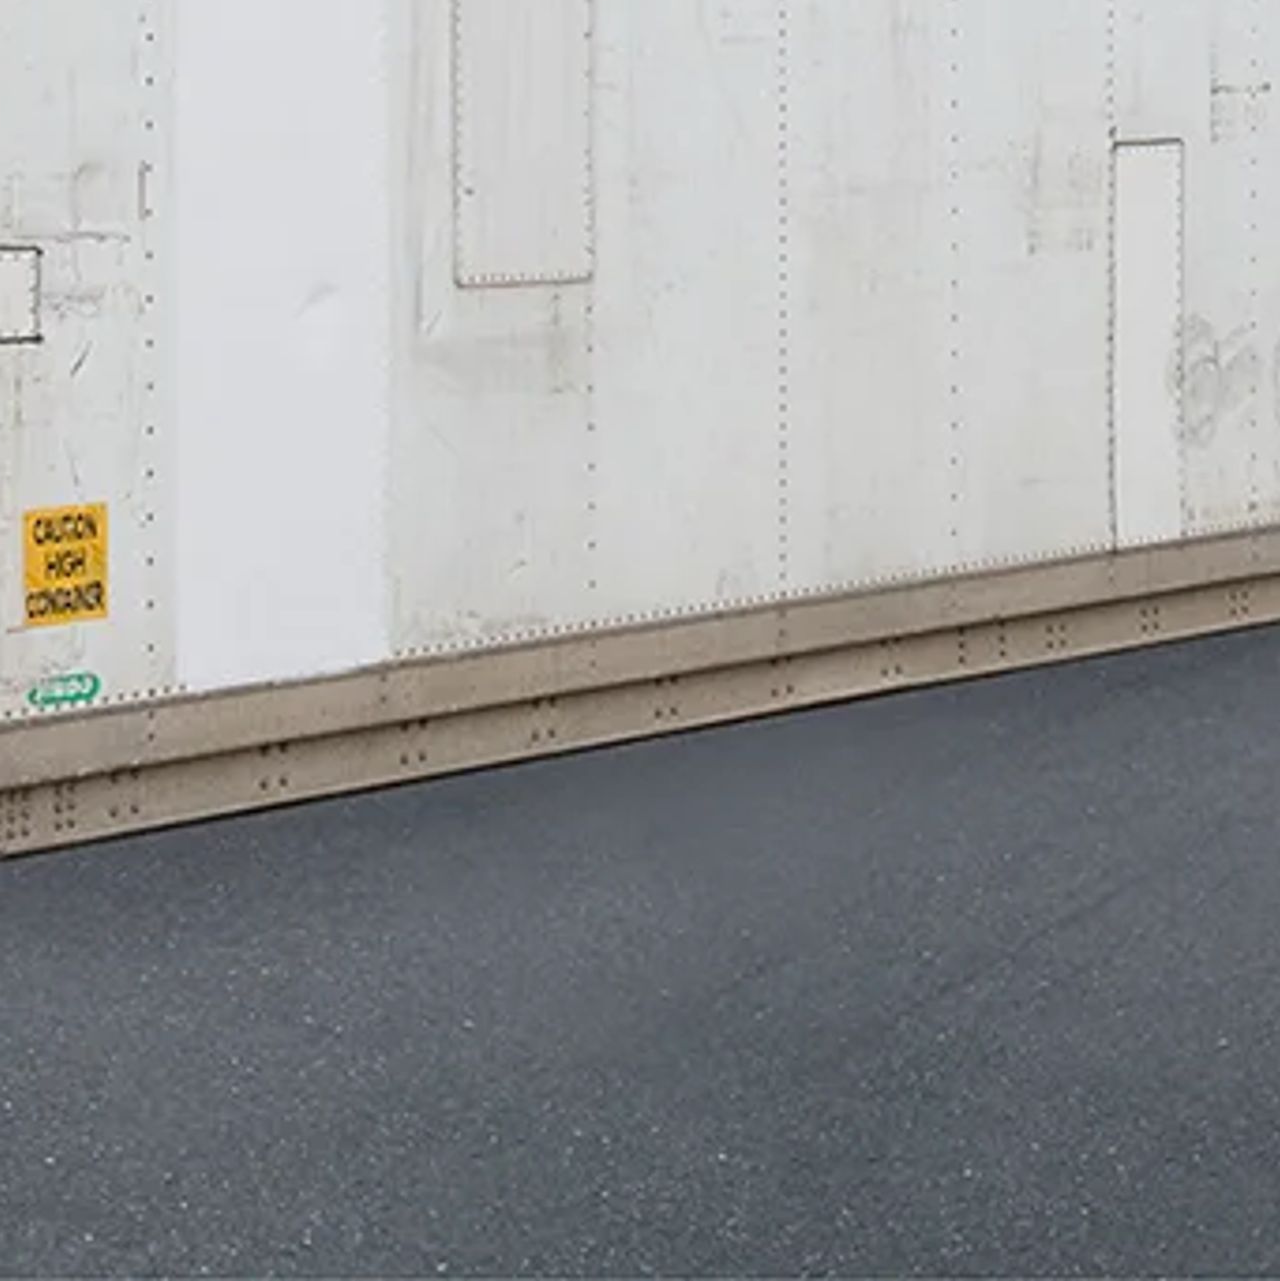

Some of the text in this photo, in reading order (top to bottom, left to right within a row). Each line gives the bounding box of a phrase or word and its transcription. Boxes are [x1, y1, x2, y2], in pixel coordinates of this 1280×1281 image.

[32, 513, 98, 546] CAUTION
[44, 547, 87, 580] HIGH
[25, 580, 106, 619] CONTAINER
